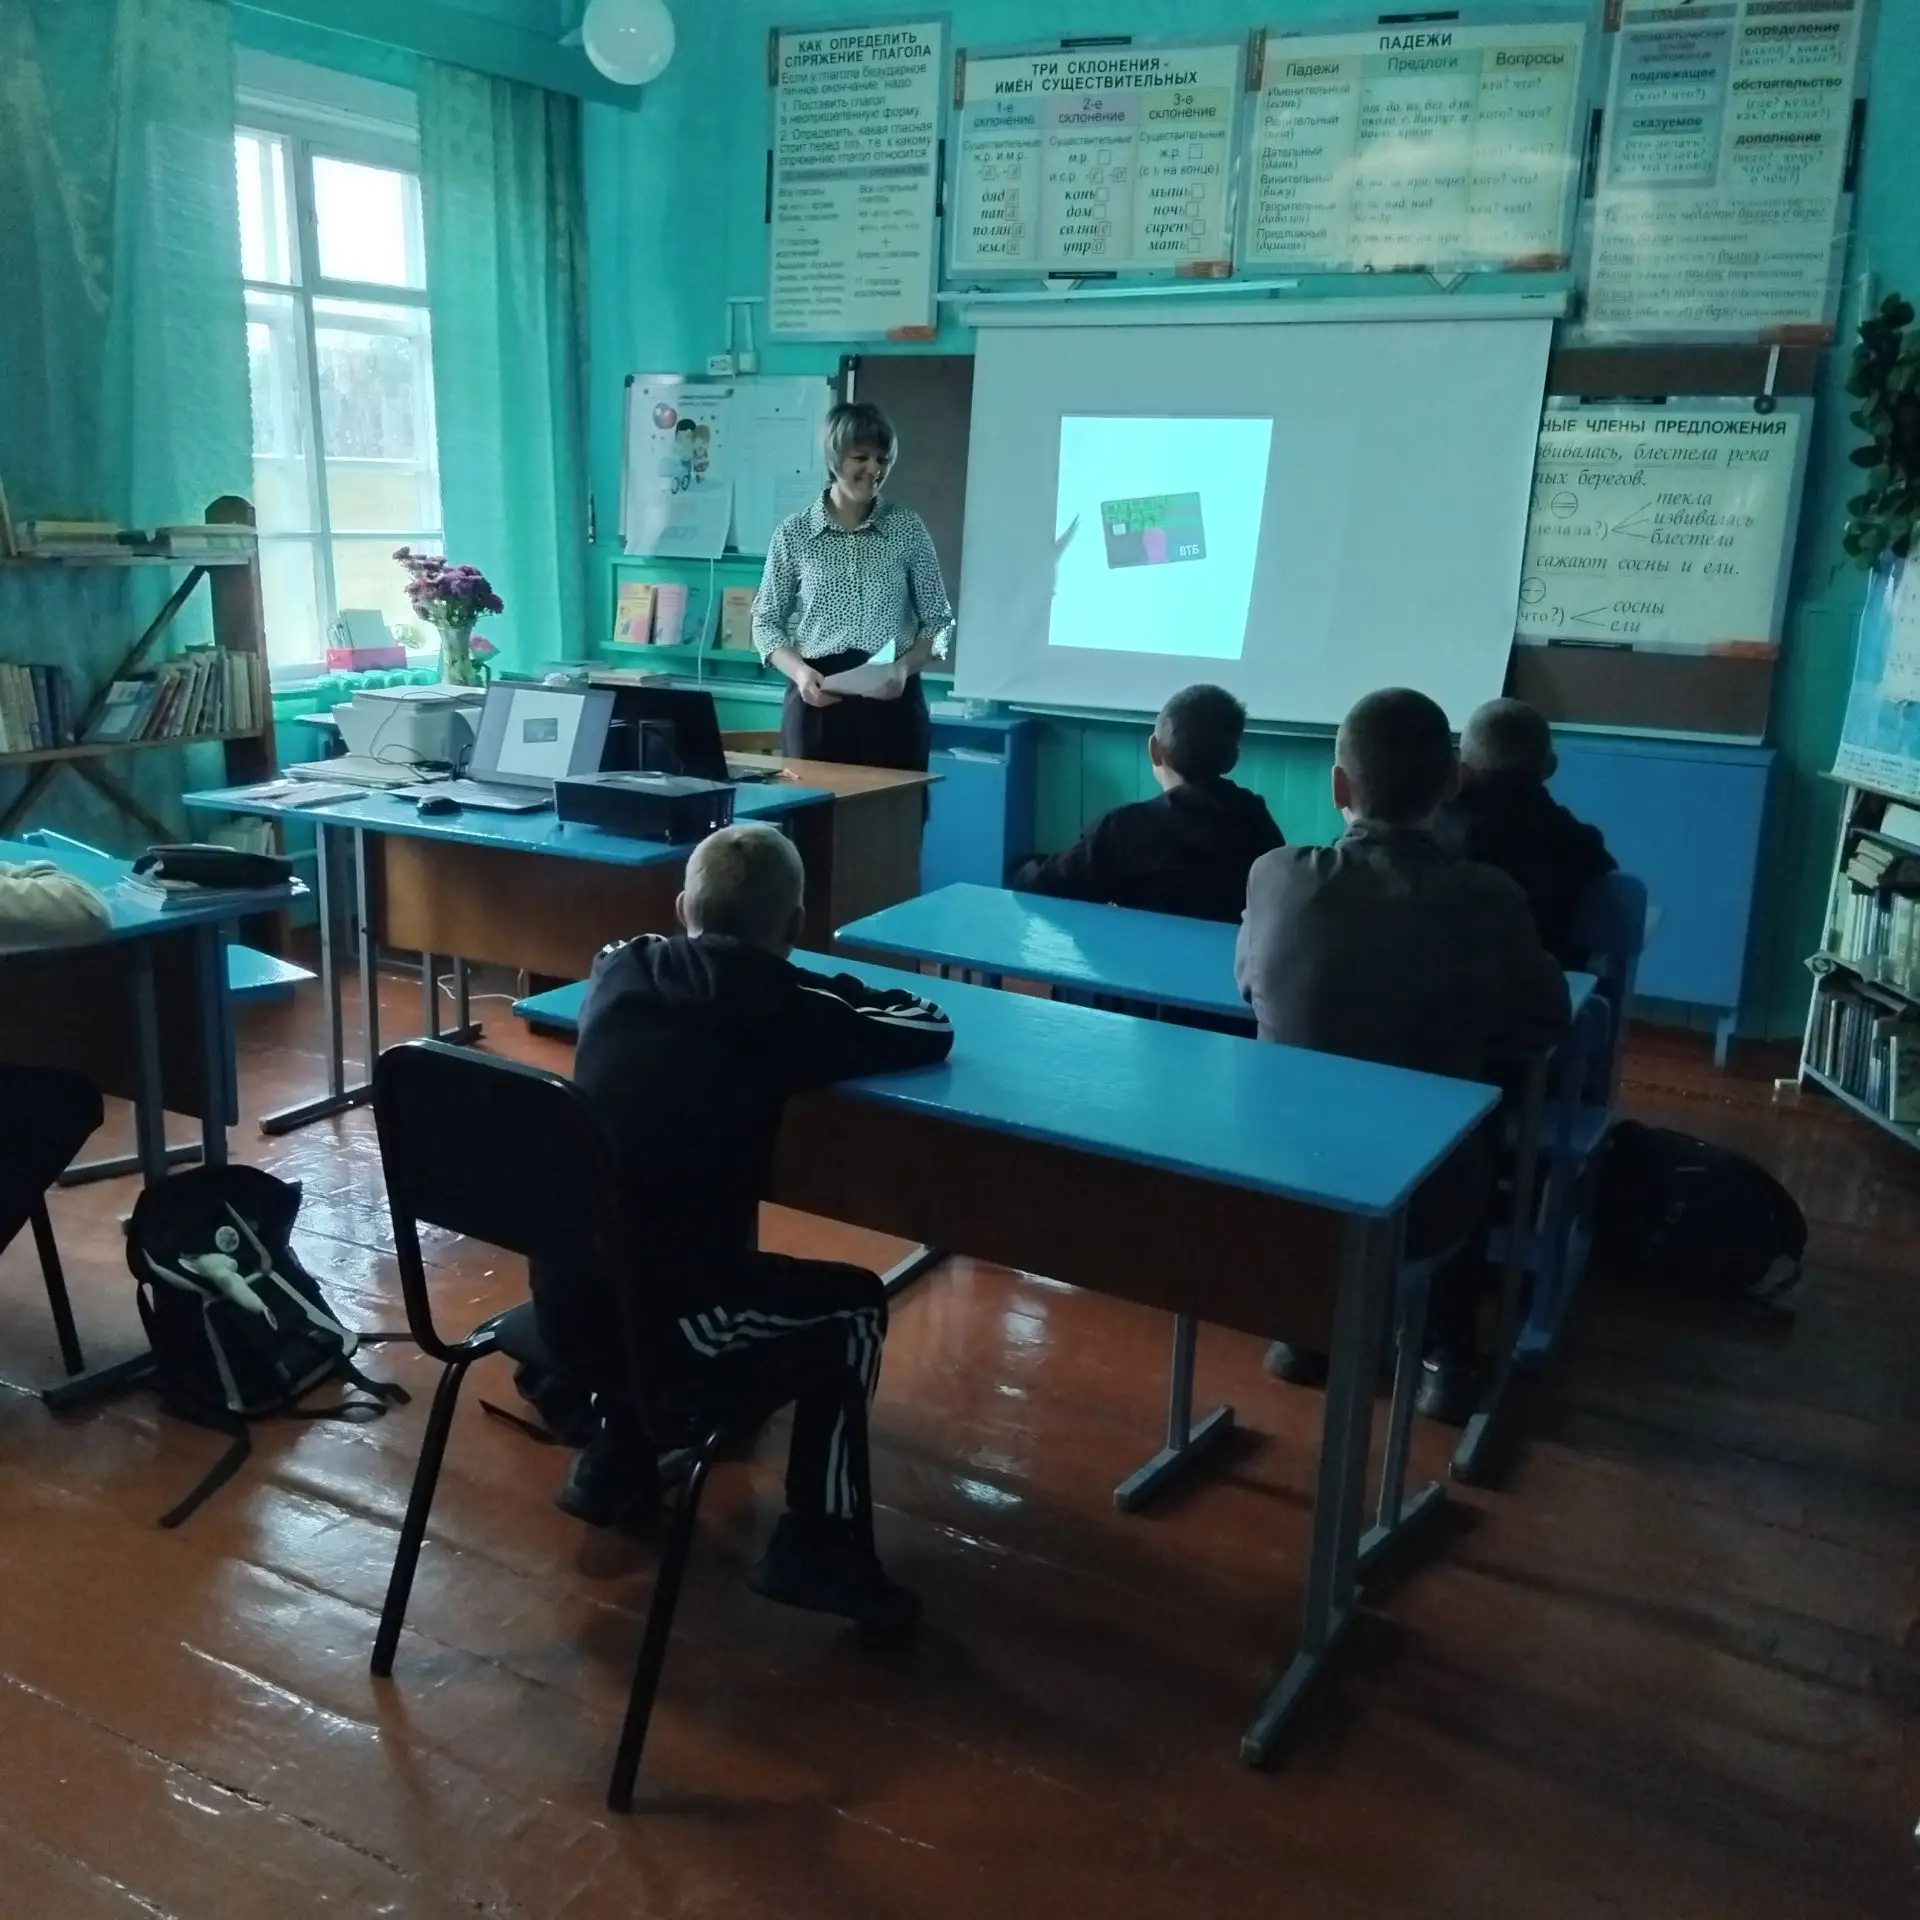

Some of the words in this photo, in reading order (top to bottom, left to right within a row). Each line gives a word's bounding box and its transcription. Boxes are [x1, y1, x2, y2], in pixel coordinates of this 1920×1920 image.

[1745, 22, 1841, 38] определение
[799, 40, 822, 52] КАК
[830, 32, 917, 50] ОПРЕДЕЛИТЬ
[1379, 32, 1452, 51] ПАДЕЖИ
[785, 51, 864, 68] СПРЯЖЕНИЕ
[872, 45, 931, 60] ГЛАГОЛА
[1388, 55, 1459, 74] Предлоги
[1496, 51, 1564, 68] Вопросы
[1032, 63, 1058, 77] ТРИ
[1067, 58, 1160, 75] СКЛОНЕНИЯ
[1286, 62, 1340, 79] Падежи
[1630, 67, 1717, 82] подлежащее
[995, 77, 1034, 94] ИМЁН
[1042, 72, 1198, 92] СУЩЕСТВИТЕЛЬНЫХ
[1732, 77, 1842, 91] обстоятельство
[1082, 97, 1103, 110] 2-е
[1173, 92, 1193, 106] 3-е
[997, 102, 1014, 114] 1-е
[1149, 105, 1217, 121] склонение
[973, 114, 1036, 128] склонение
[1058, 110, 1126, 125] склонение
[1632, 117, 1704, 132] сказуемое
[1736, 131, 1822, 146] дополнение
[1586, 419, 1645, 433] ЧЛЕНЫ
[1655, 419, 1787, 435] ПРЕДЛОЖЕНИЯ
[1634, 442, 1718, 461] блестела
[1725, 447, 1769, 468] река
[1578, 468, 1647, 490] берегов.
[1657, 491, 1712, 505] текла
[1654, 508, 1754, 527] извивалась
[1649, 528, 1735, 548] блестела
[1178, 544, 1200, 557] ВТБ
[1537, 554, 1608, 570] сажают
[1618, 558, 1672, 573] сосны
[1681, 561, 1693, 573] и
[1703, 561, 1740, 577] ели.
[1612, 598, 1665, 614] сосны
[1609, 619, 1640, 633] ели
